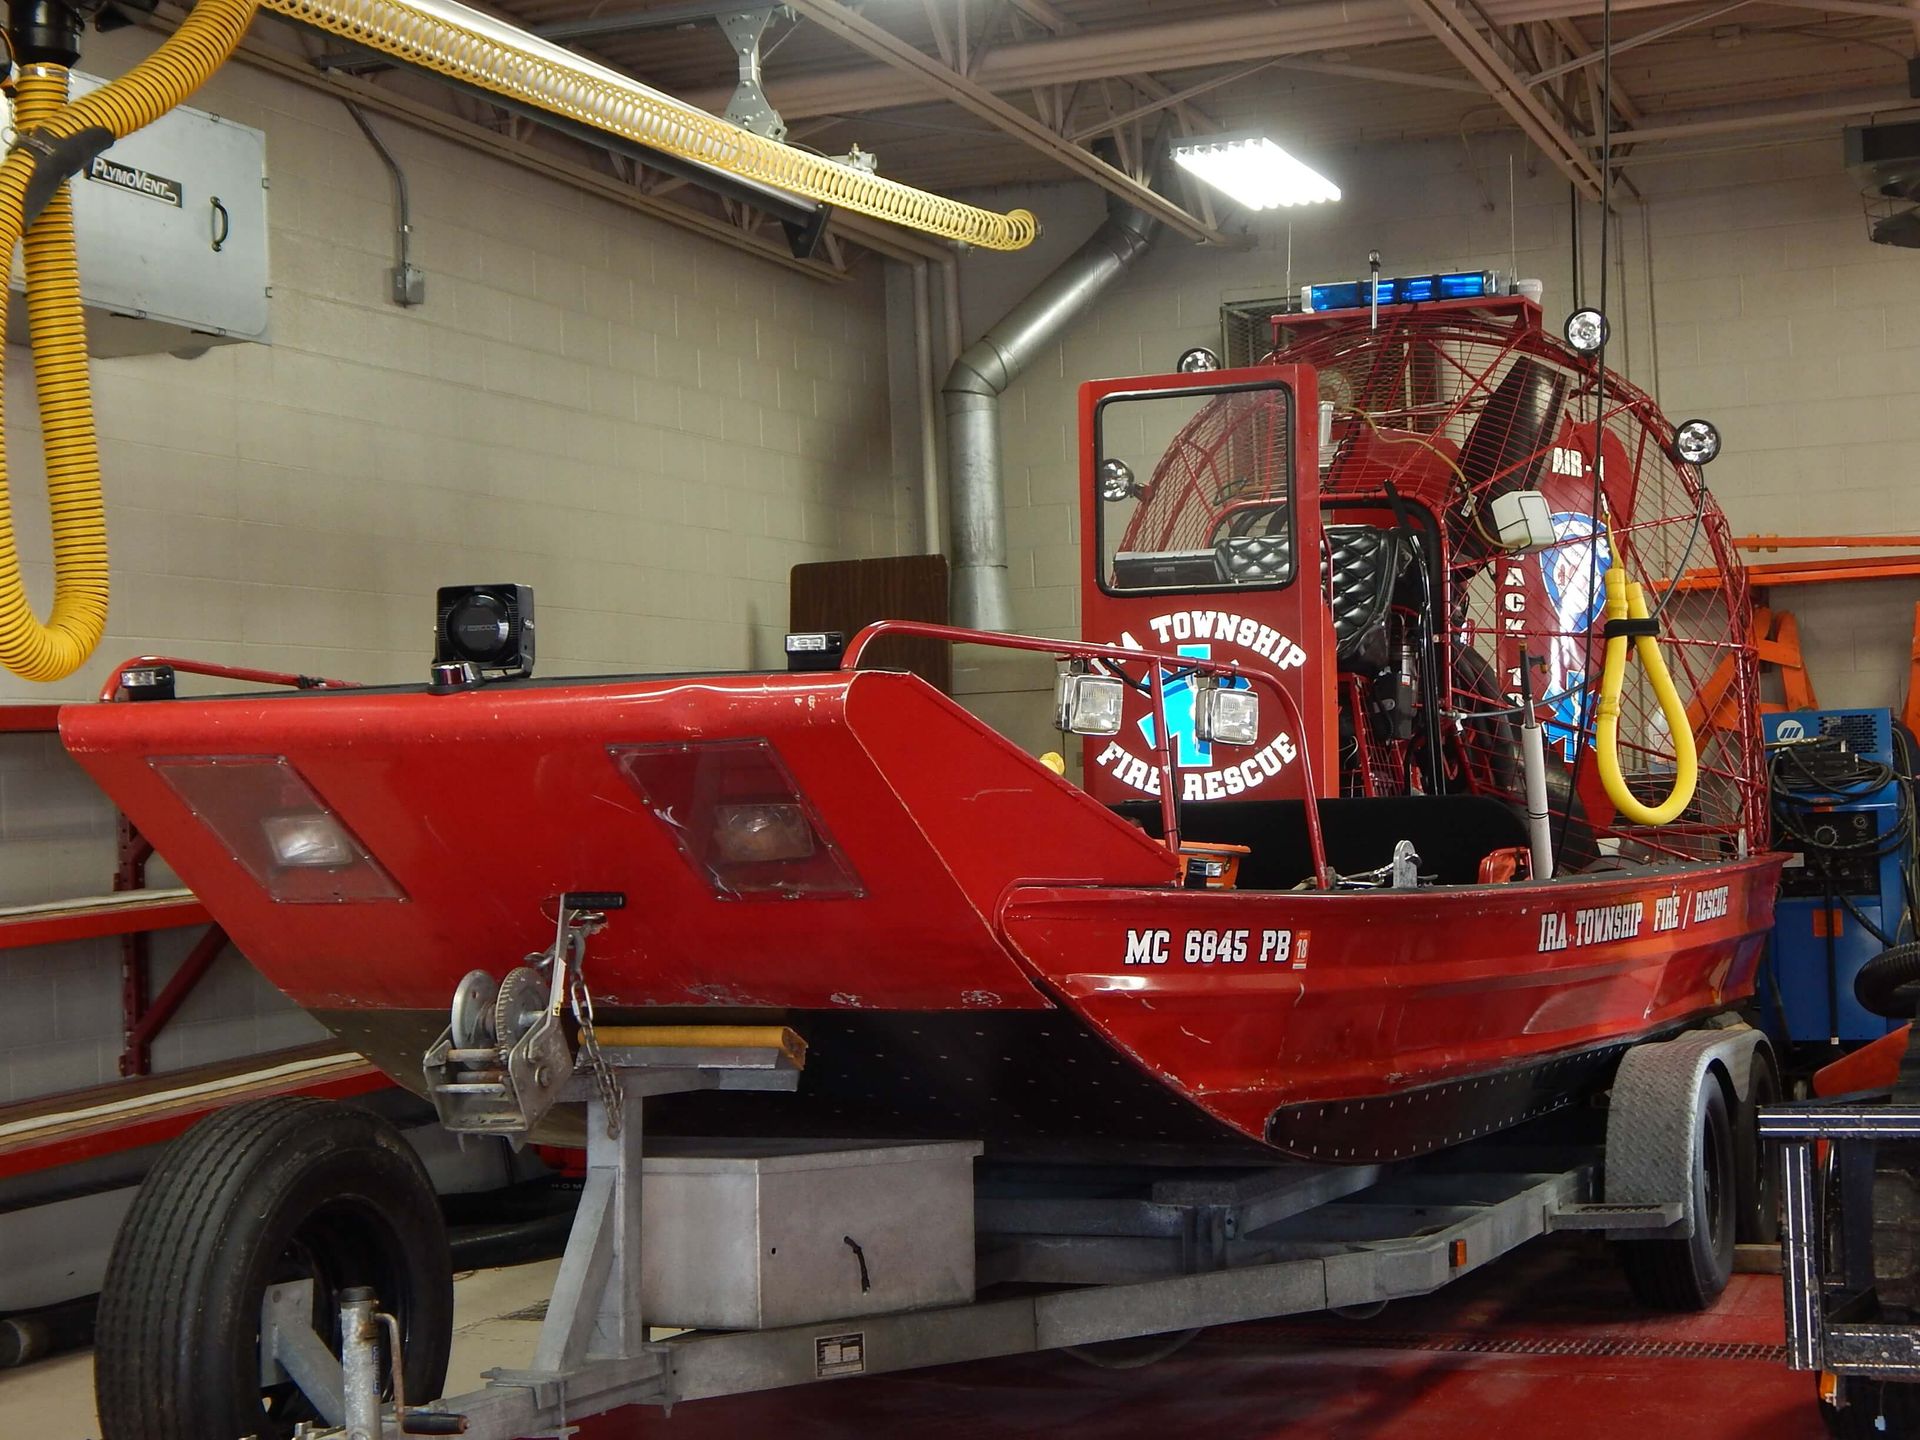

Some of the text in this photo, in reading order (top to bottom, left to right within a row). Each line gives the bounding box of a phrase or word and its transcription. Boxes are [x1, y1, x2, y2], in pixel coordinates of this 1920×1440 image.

[1149, 610, 1307, 671] TOWNSHIP
[1182, 731, 1298, 801] RESCUE
[1124, 929, 1293, 964] MC 6845 PB
[1296, 938, 1308, 959] 18
[1537, 912, 1568, 952] IRA
[1575, 902, 1644, 947] TOWNSHIP
[1653, 893, 1681, 932] FIRE
[1694, 886, 1730, 923] RESCUE
